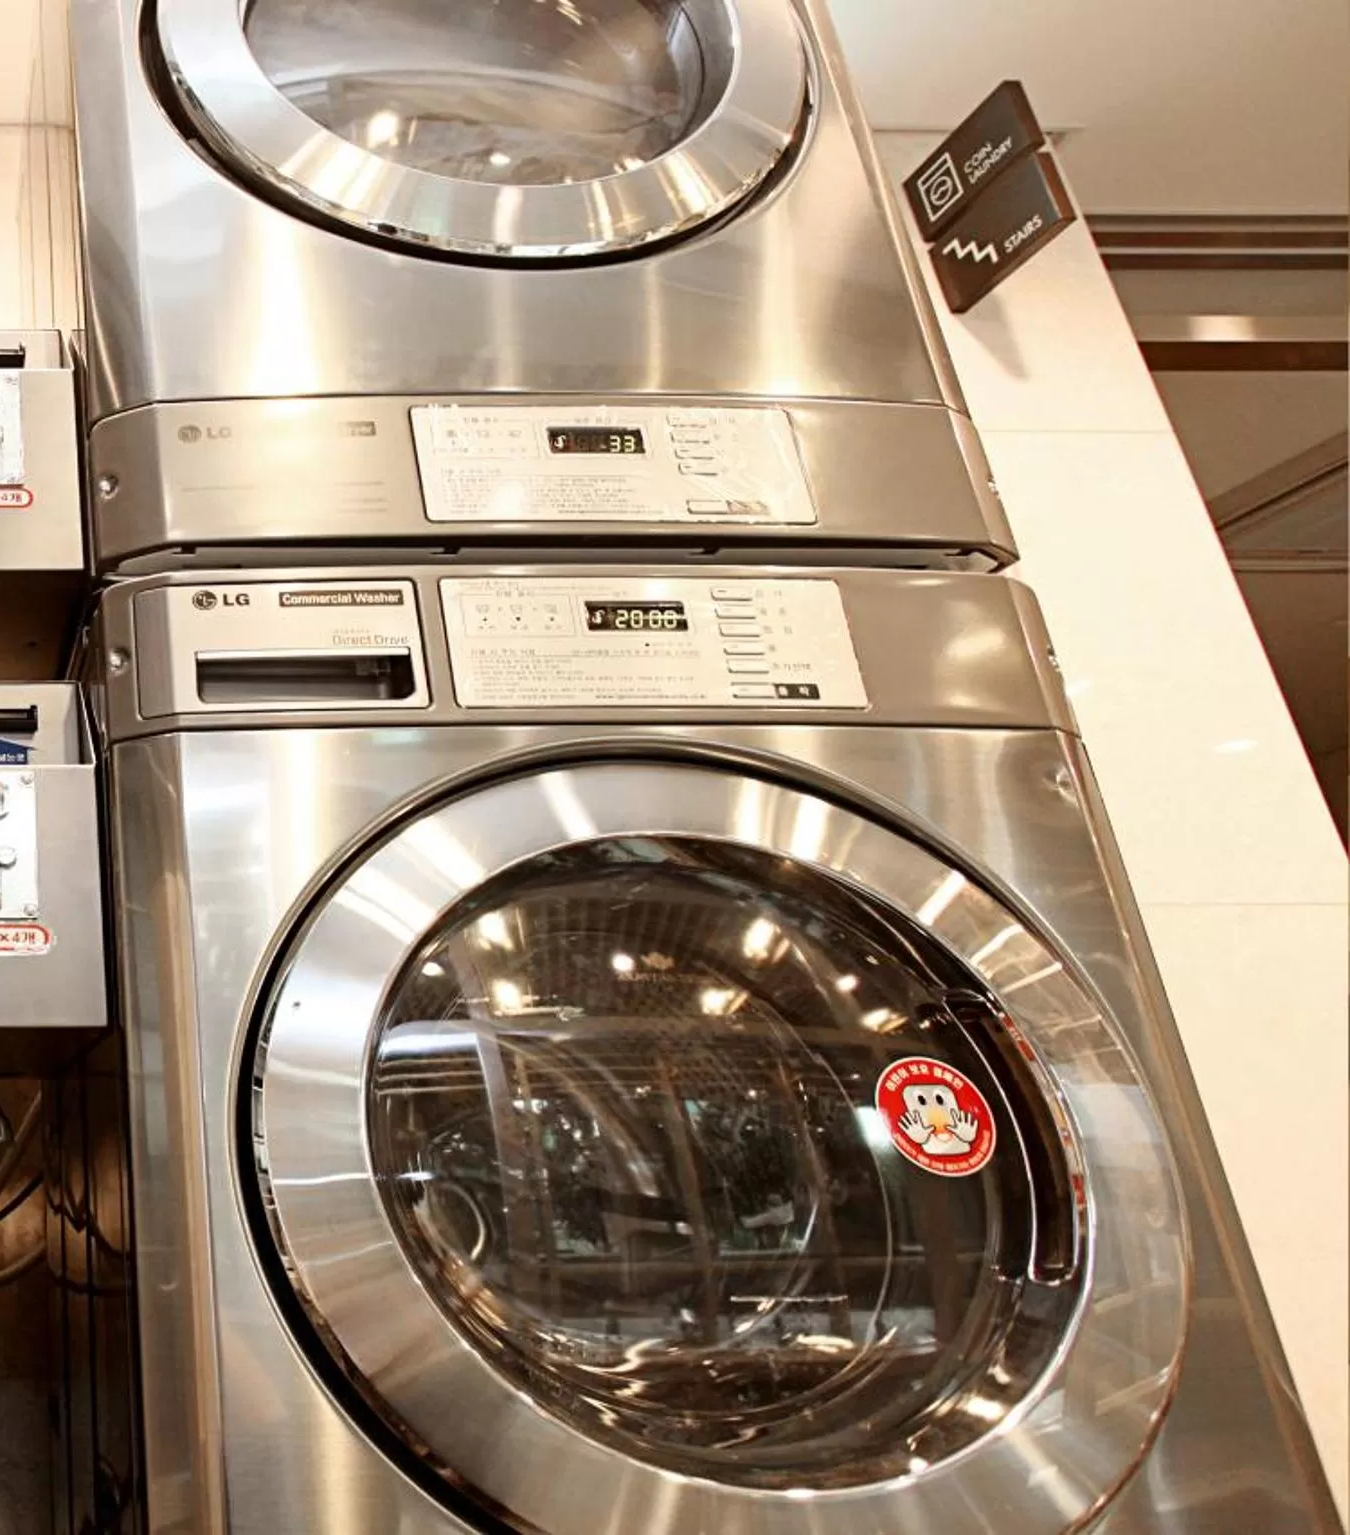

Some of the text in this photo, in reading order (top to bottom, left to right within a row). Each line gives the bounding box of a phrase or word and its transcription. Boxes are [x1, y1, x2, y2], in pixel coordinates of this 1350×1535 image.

[964, 142, 994, 174] COIN
[967, 136, 1013, 185] LAUNDRY
[1003, 213, 1043, 254] STAIRS
[206, 427, 232, 439] LG
[222, 593, 250, 606] LG
[282, 592, 401, 606] Commercial Washer
